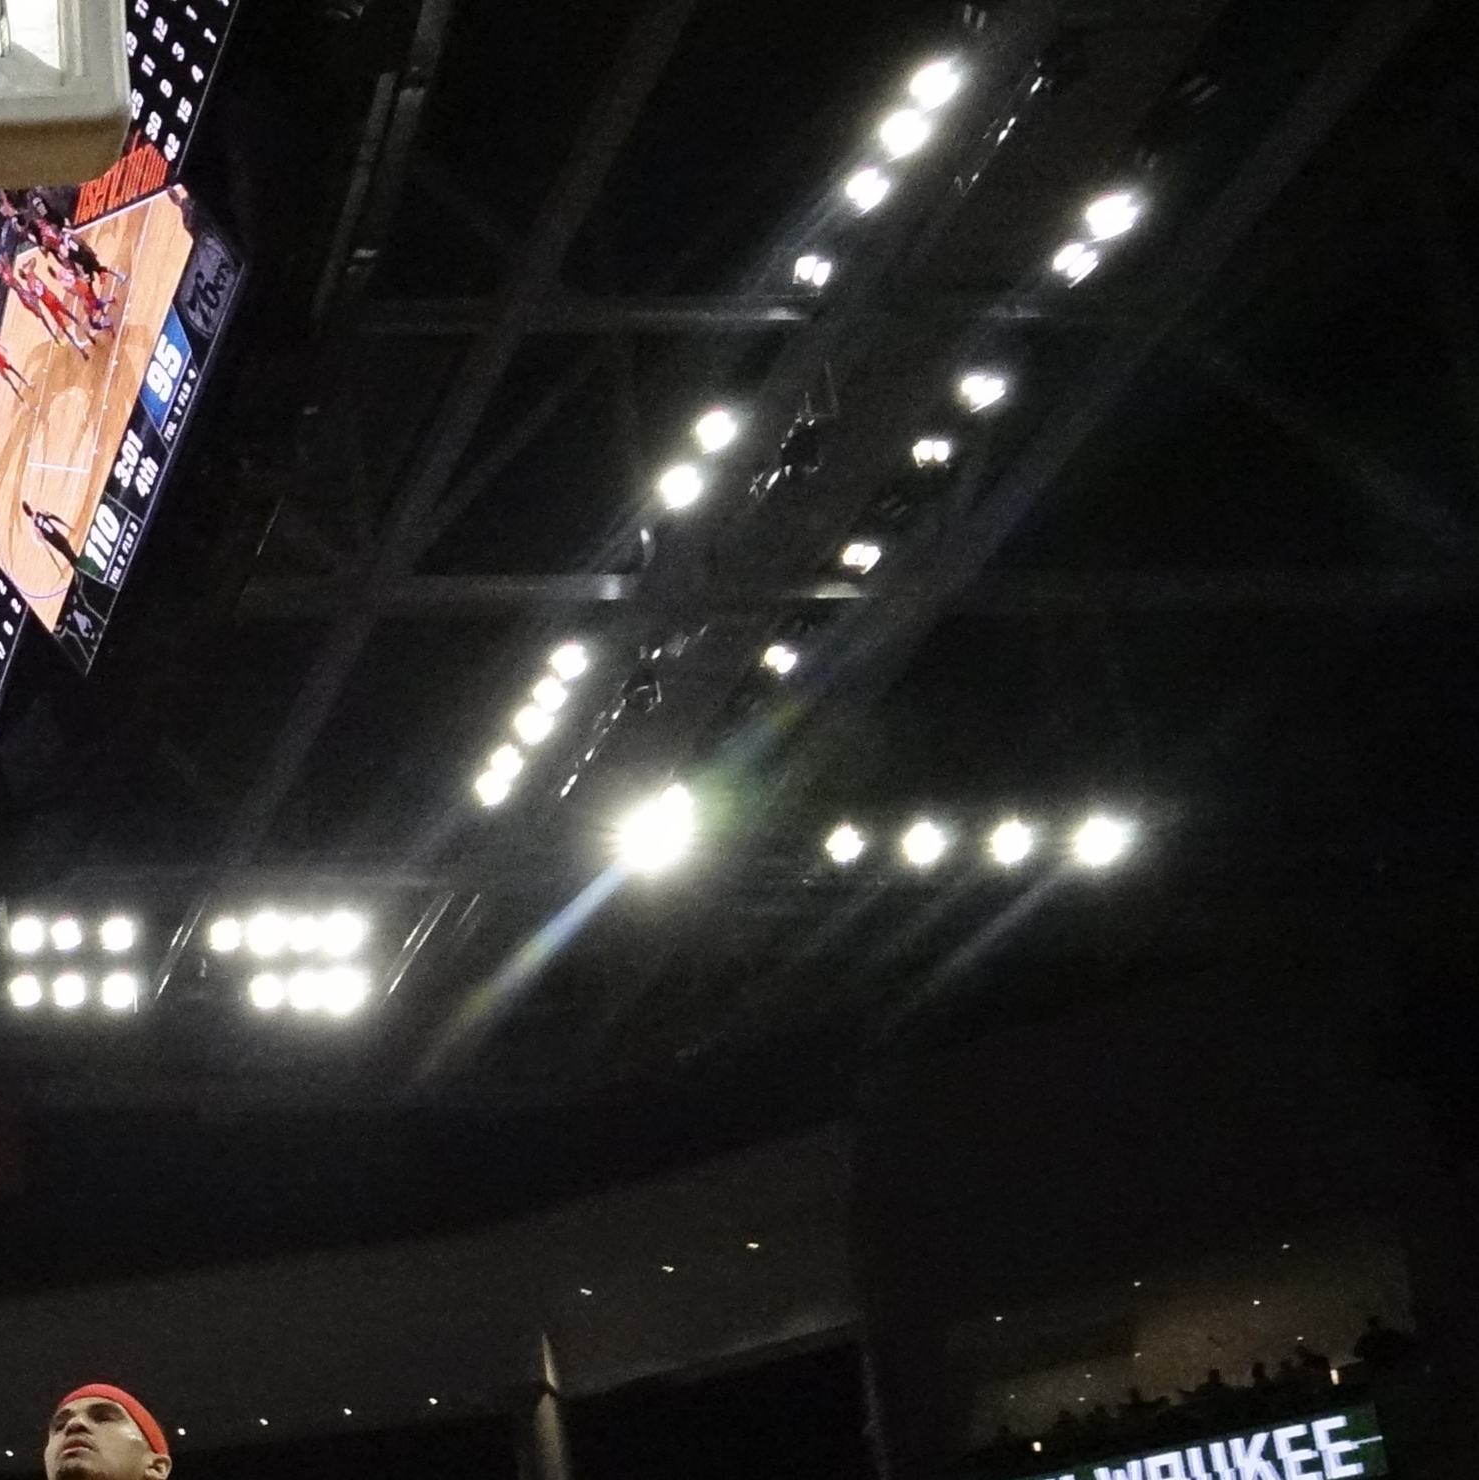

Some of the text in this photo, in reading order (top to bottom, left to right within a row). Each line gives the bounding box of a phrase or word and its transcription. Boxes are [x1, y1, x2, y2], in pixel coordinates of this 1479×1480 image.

[147, 334, 182, 403] 95
[114, 429, 143, 489] 3:01
[134, 457, 159, 498] 4th
[85, 504, 121, 572] 110
